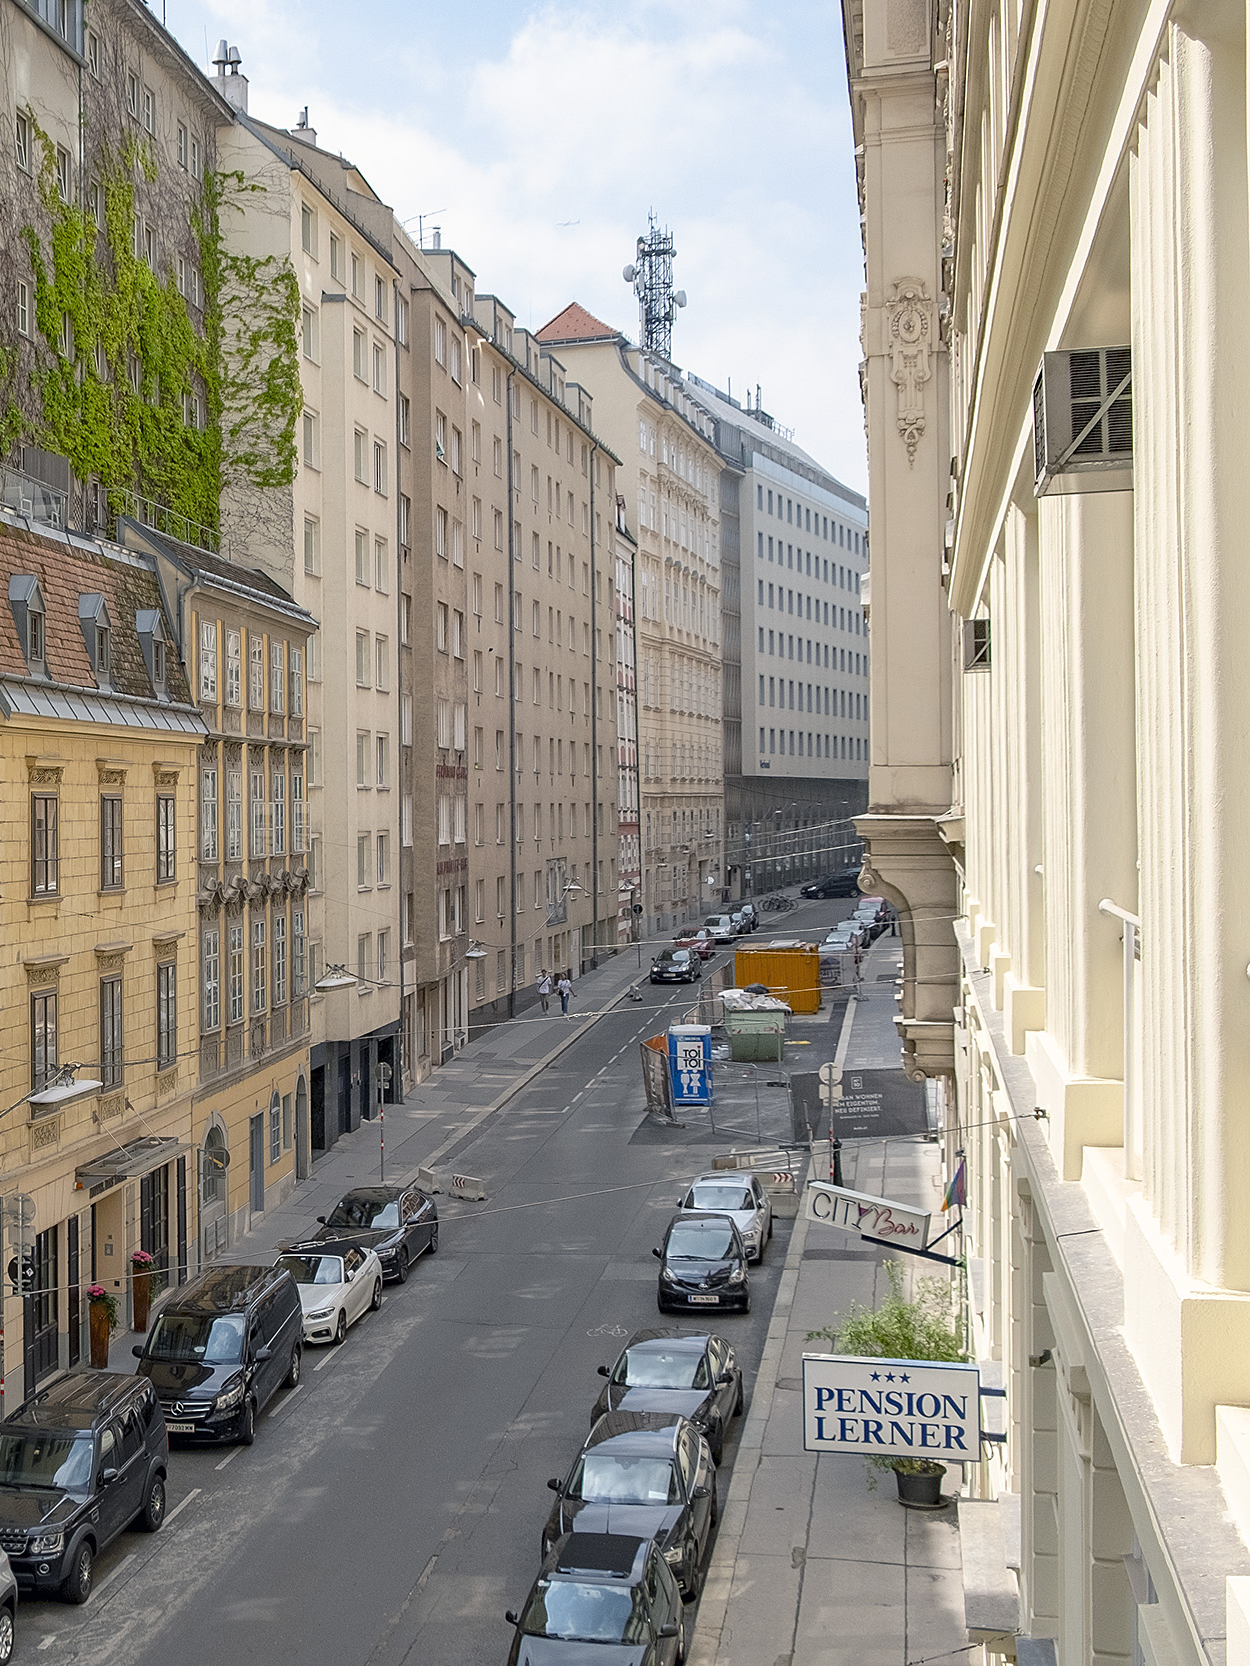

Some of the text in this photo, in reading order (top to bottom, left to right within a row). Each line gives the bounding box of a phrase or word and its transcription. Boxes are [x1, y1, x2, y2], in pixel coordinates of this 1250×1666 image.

[683, 1058, 701, 1068] TOI
[813, 1192, 920, 1238] CITY Bar
[814, 1386, 969, 1420] PENSION
[814, 1416, 969, 1450] LERNER
